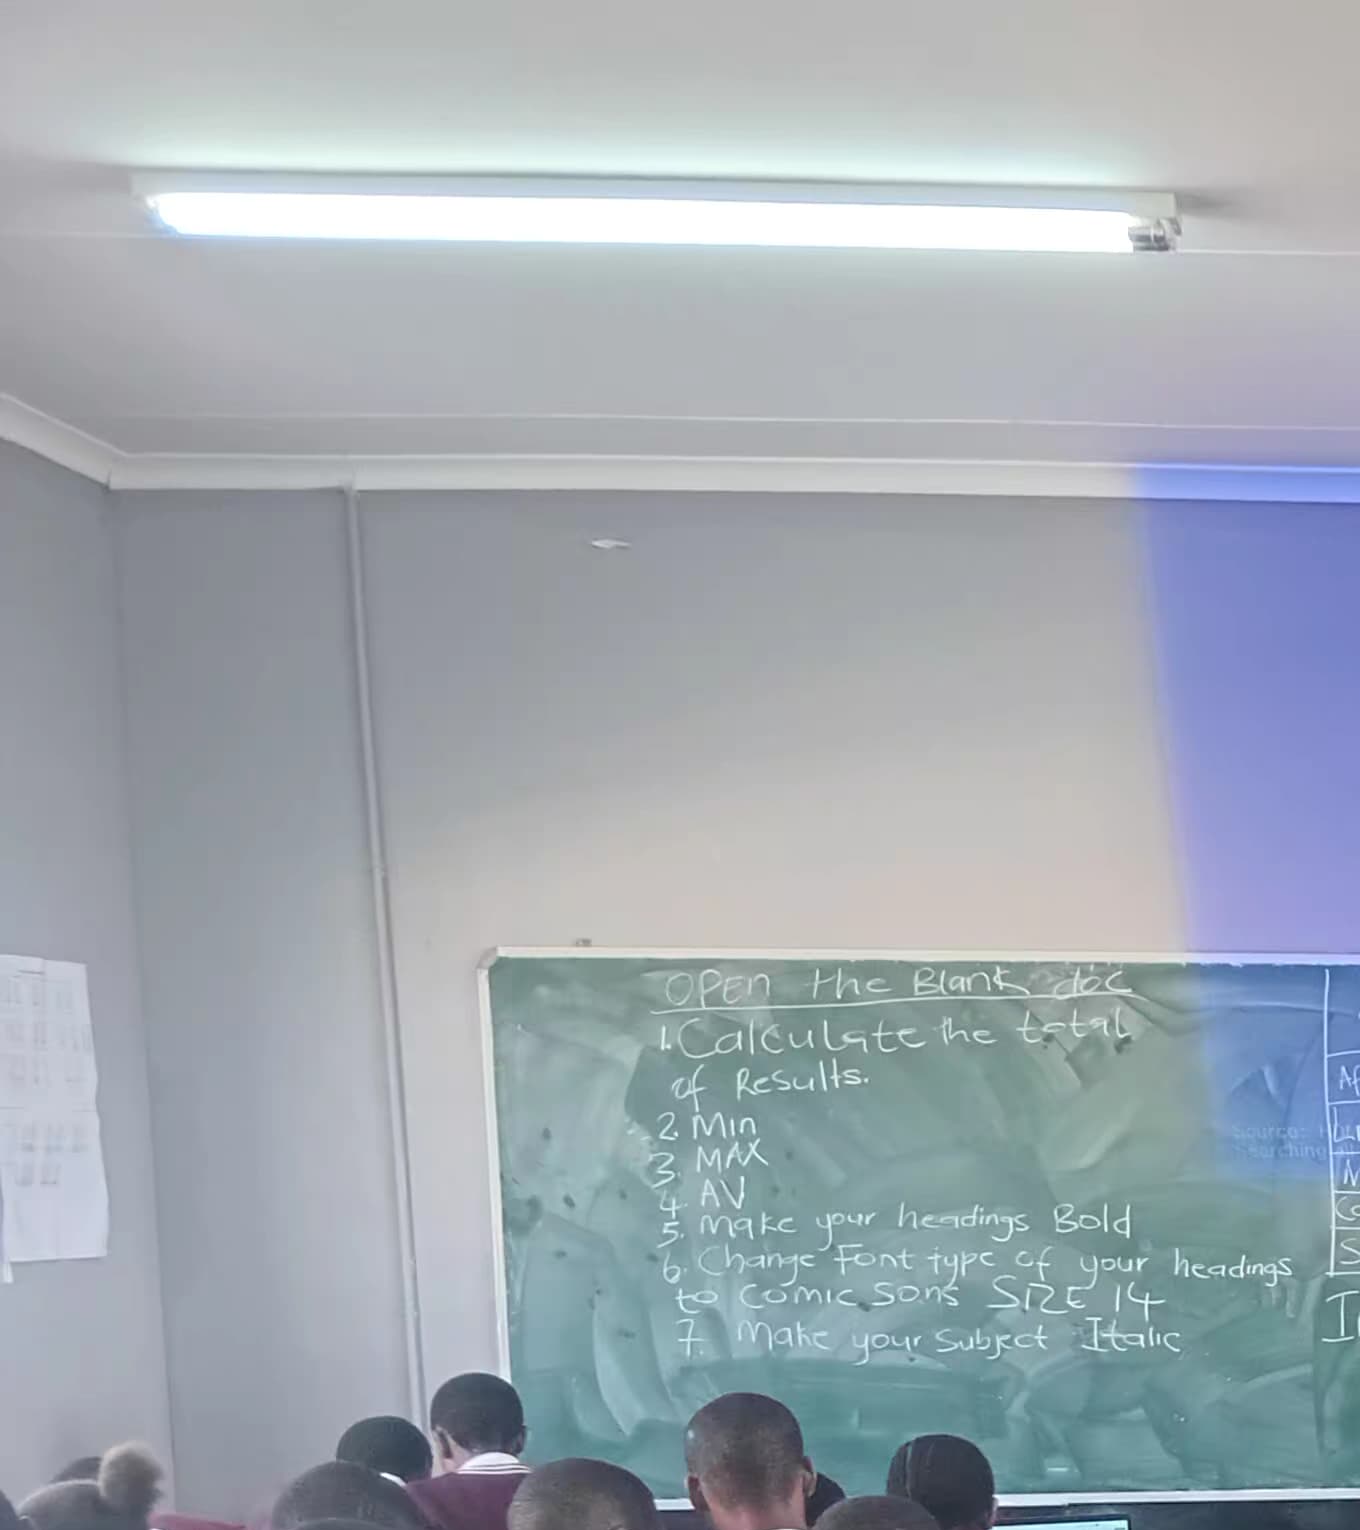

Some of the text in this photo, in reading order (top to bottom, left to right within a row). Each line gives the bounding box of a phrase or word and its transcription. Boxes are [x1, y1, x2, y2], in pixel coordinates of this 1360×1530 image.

[804, 967, 892, 999] the
[914, 966, 1031, 996] Blank
[678, 1018, 926, 1058] Calculate
[936, 1015, 998, 1045] the
[1016, 1007, 1132, 1043] total
[672, 1064, 707, 1112] of
[657, 1112, 678, 1140] 2.
[696, 1138, 768, 1172] MAX
[701, 1176, 744, 1208] AV
[657, 1222, 685, 1248] 5.
[816, 1211, 876, 1251] your
[898, 1202, 1030, 1241] headings
[1054, 1203, 1131, 1239] Bold
[698, 1244, 817, 1286] Change
[928, 1246, 996, 1290] type
[1015, 1246, 1053, 1282] of
[1080, 1254, 1150, 1289] your
[1174, 1248, 1293, 1287] headings
[676, 1288, 718, 1314] to
[1115, 1282, 1167, 1322] 14
[852, 1333, 922, 1366] your
[1081, 1317, 1181, 1352] Italic
